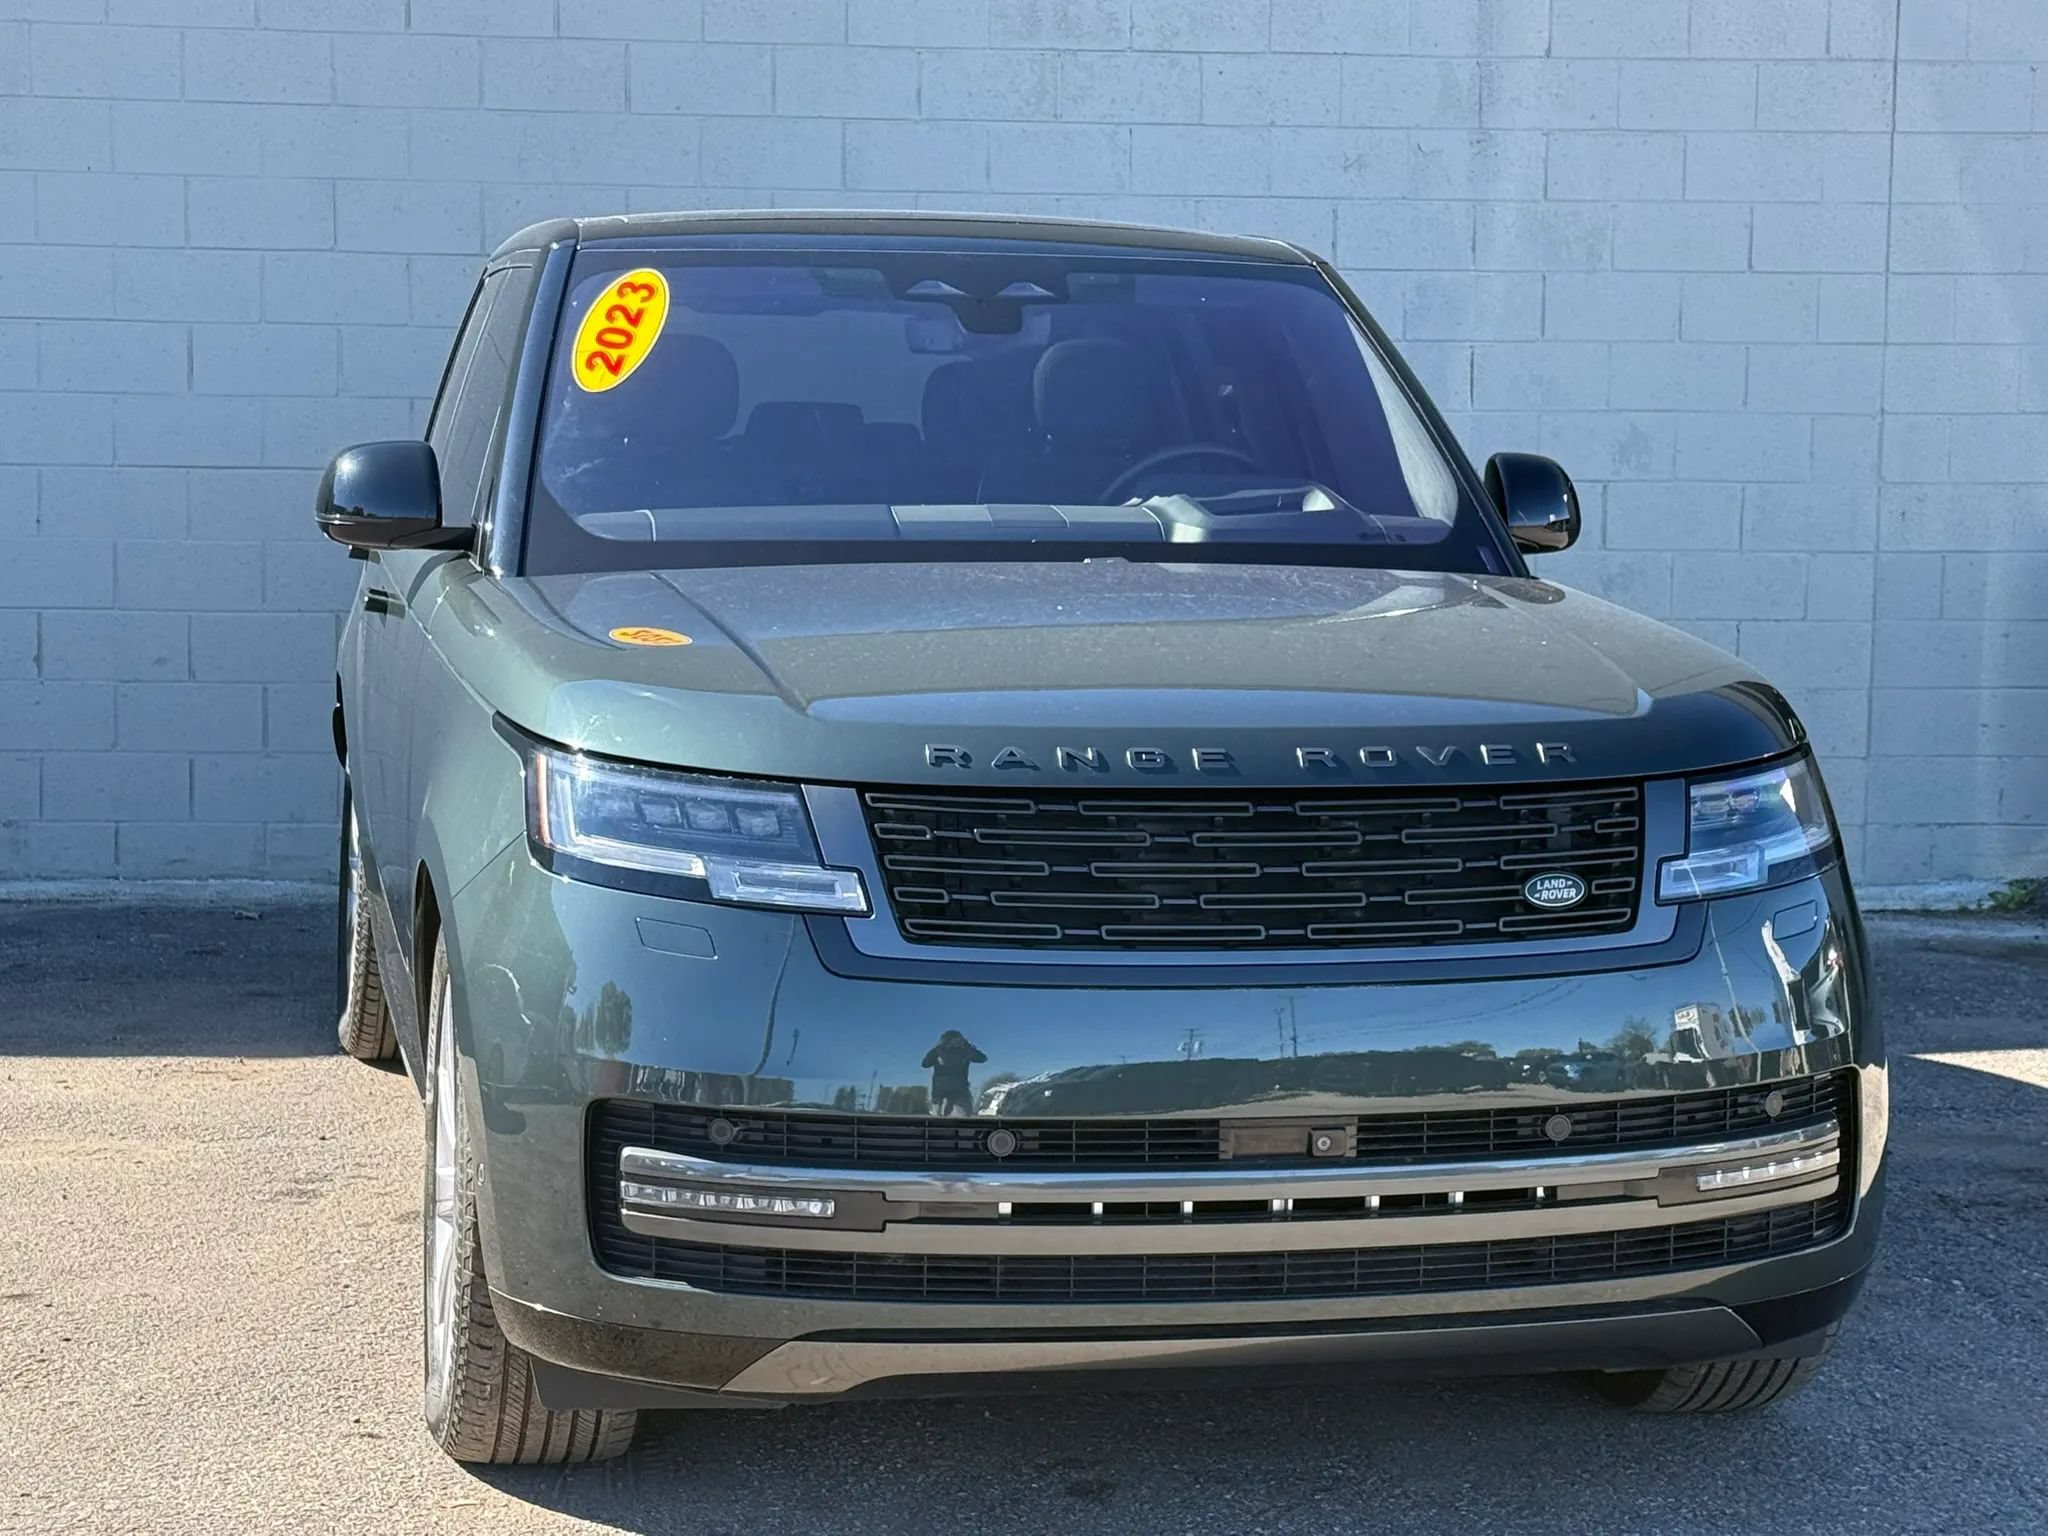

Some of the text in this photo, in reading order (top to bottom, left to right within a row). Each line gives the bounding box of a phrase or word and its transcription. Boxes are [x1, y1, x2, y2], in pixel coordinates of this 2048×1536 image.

[585, 280, 656, 377] 2023
[924, 742, 1577, 770] RANGE ROVER
[1536, 878, 1566, 890] LAND
[1540, 887, 1577, 901] ROVER
